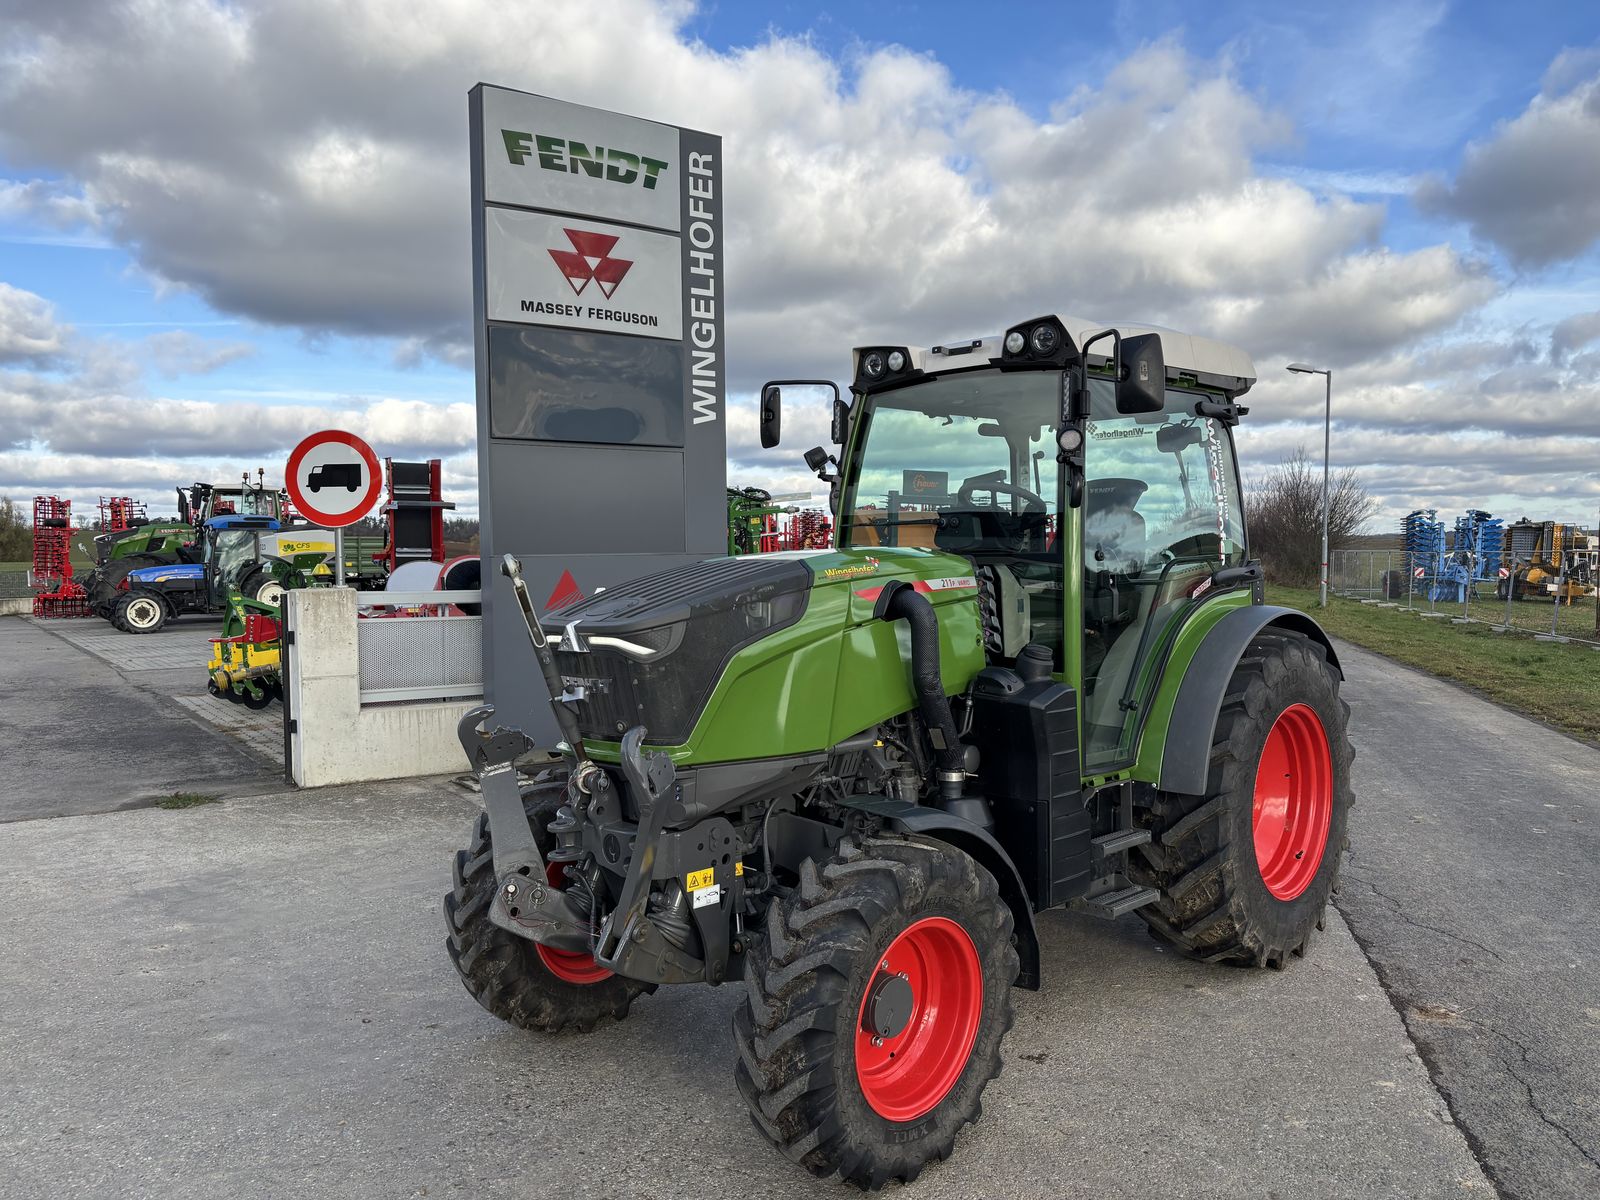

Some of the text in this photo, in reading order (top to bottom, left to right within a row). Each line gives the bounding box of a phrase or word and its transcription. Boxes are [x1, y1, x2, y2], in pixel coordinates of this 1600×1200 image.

[501, 129, 668, 190] FENDT
[521, 300, 657, 326] MASSEY FERGUSON
[689, 151, 716, 425] WINGELHOFER
